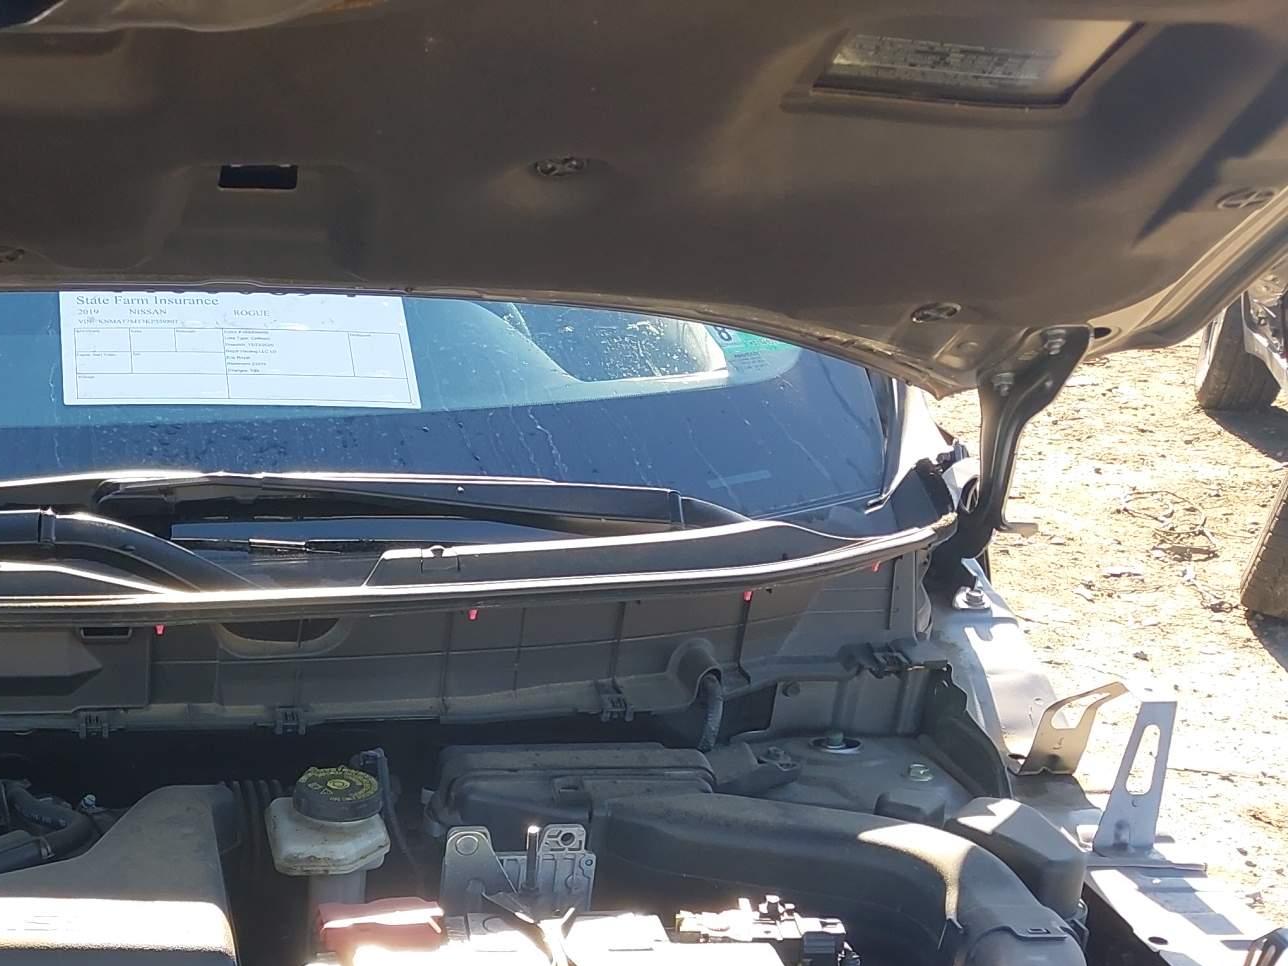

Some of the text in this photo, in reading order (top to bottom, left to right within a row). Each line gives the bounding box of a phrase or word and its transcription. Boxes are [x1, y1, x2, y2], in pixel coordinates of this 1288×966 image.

[76, 295, 220, 305] State Farm Insurance
[128, 308, 167, 316] NISSAN
[233, 309, 271, 317] ROGUE
